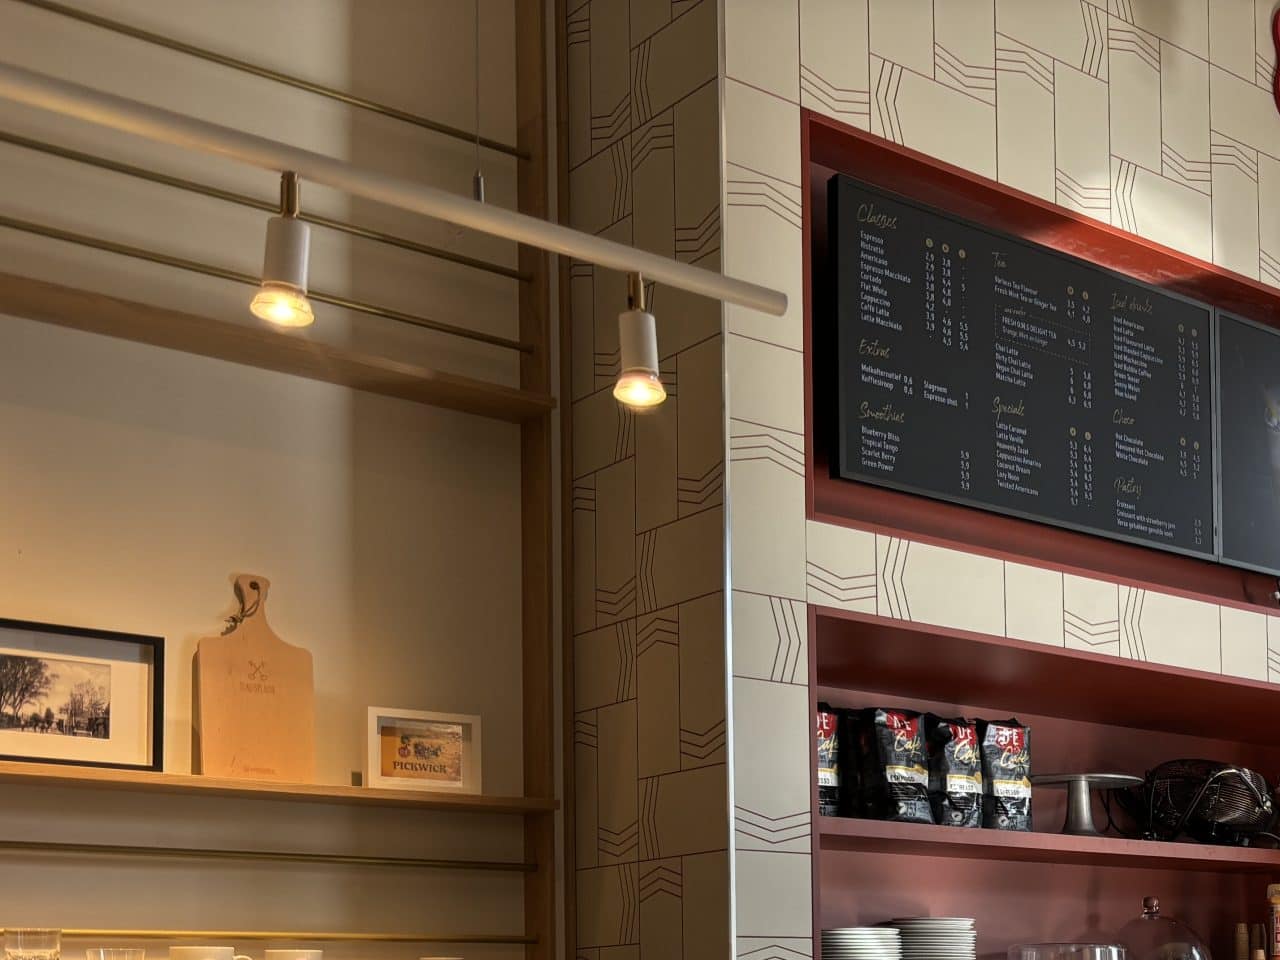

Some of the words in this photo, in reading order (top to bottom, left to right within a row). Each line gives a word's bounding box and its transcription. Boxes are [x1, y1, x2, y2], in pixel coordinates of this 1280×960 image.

[860, 230, 884, 245] Espresso
[860, 251, 888, 266] Americano
[860, 261, 884, 275] Espresso
[884, 269, 911, 283] Macchiato
[860, 271, 882, 285] Cortado
[860, 281, 870, 291] Flat
[870, 285, 888, 296] White
[860, 291, 890, 307] Cappuccino
[876, 306, 890, 317] Latte
[861, 313, 875, 323] Latte
[876, 316, 902, 331] Macchiato
[859, 338, 890, 359] Extras
[995, 342, 1005, 352] Chai
[1006, 346, 1019, 356] Latte
[995, 362, 1009, 373] Vegan
[1010, 366, 1020, 376] Chai
[1021, 370, 1033, 379] Latte
[1008, 356, 1018, 366] Chai
[1018, 360, 1031, 370] Latte
[861, 374, 894, 391] Koffiesiroop
[1013, 377, 1026, 387] Latte
[860, 401, 905, 423] Smoothies
[991, 396, 1025, 417] Specials
[1113, 408, 1135, 425] Choco
[861, 425, 887, 440] Blueberry
[887, 432, 900, 442] Bliss
[995, 421, 1008, 431] Latte
[1008, 424, 1027, 435] Caramel
[996, 431, 1008, 440] Latte
[861, 436, 882, 448] Tropical
[883, 441, 899, 453] Tango
[861, 446, 881, 458] Scarlet
[881, 451, 895, 464] Berry
[862, 457, 877, 468] Green
[877, 461, 894, 471] Power
[1015, 464, 1031, 475] Dream
[997, 479, 1015, 490] Twisted
[1116, 499, 1136, 510] Croissant
[894, 731, 922, 758] Café
[392, 761, 448, 774] PICKWICK
